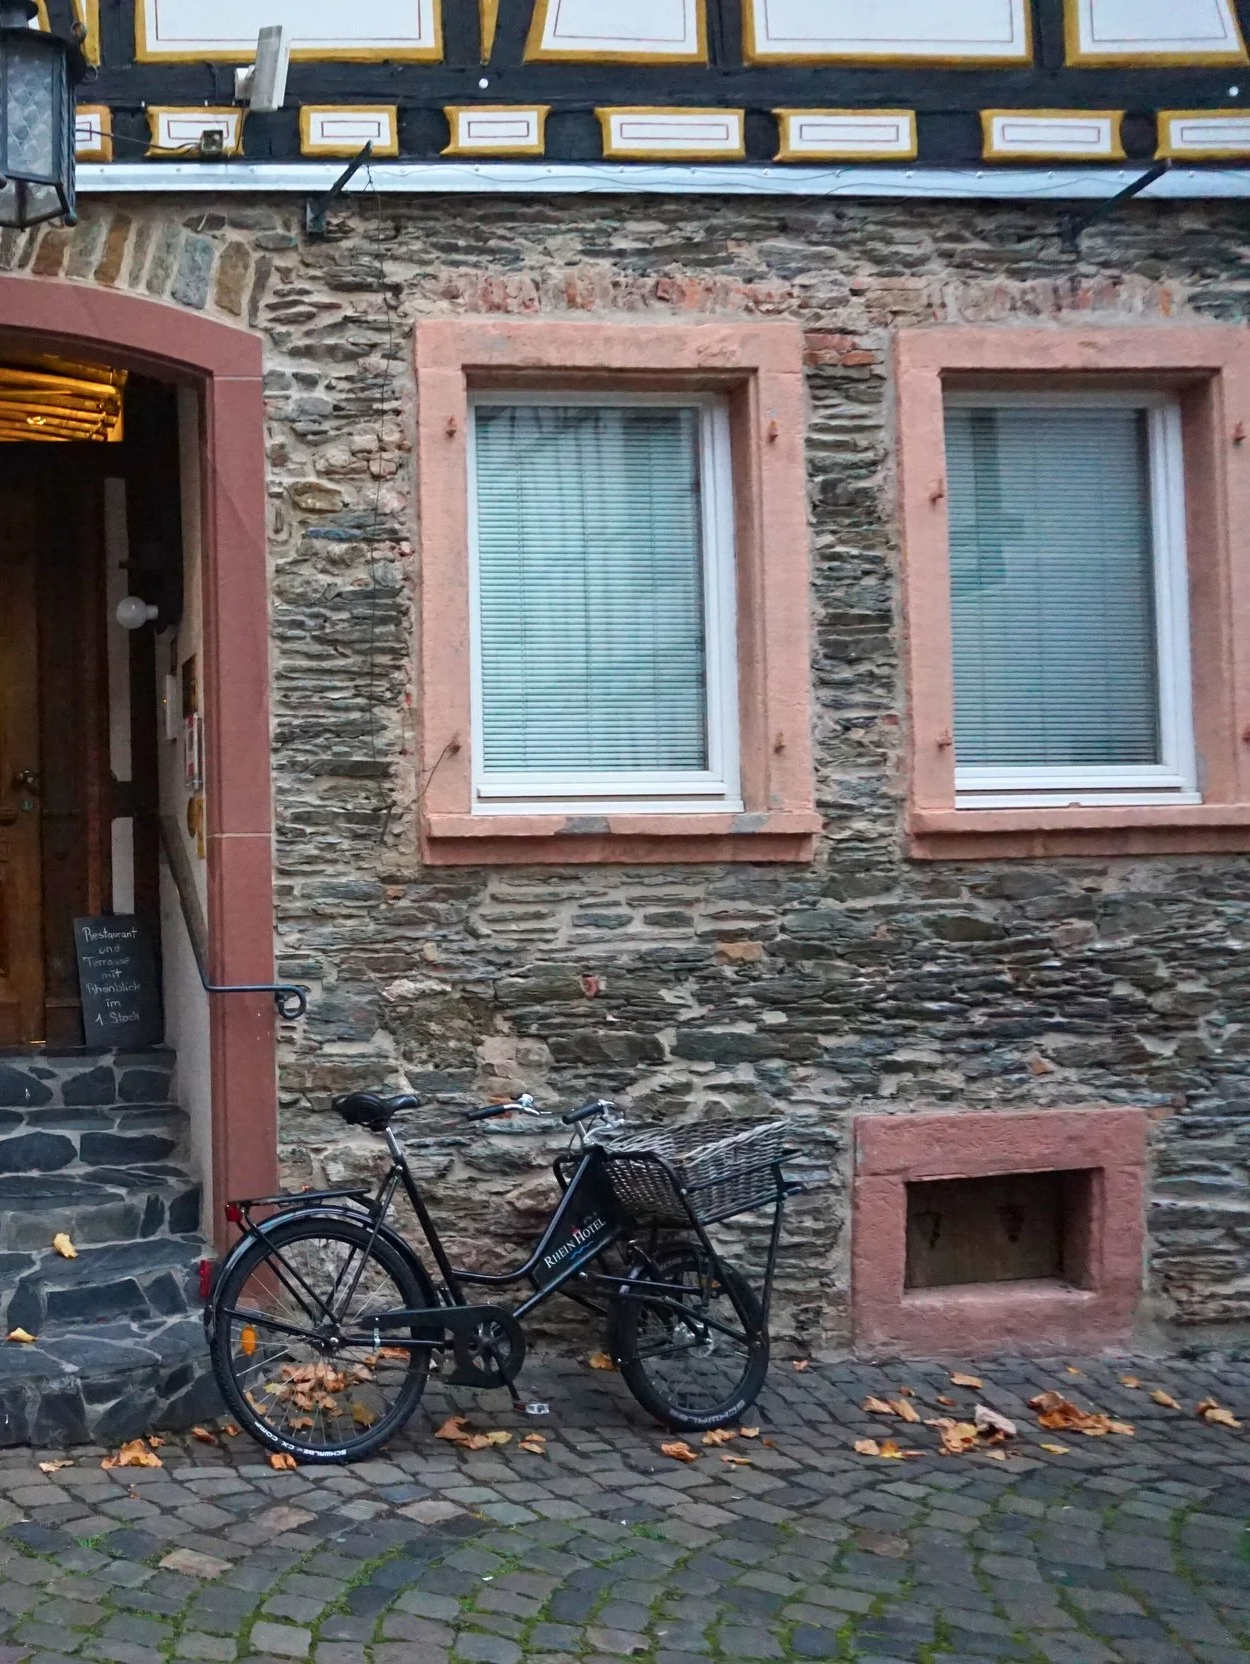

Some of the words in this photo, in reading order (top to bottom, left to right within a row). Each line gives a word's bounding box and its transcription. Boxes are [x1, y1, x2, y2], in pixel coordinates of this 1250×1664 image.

[82, 926, 138, 942] Restaurant
[98, 944, 121, 955] und
[82, 956, 131, 968] Terrasse
[101, 968, 122, 980] mit
[106, 998, 121, 1008] im
[109, 1011, 140, 1025] Stock
[544, 1240, 576, 1269] RHEIN
[573, 1218, 606, 1244] HOTEL
[254, 1421, 279, 1442] COMP
[281, 1440, 295, 1450] CX
[303, 1448, 347, 1457] SCHWALBE
